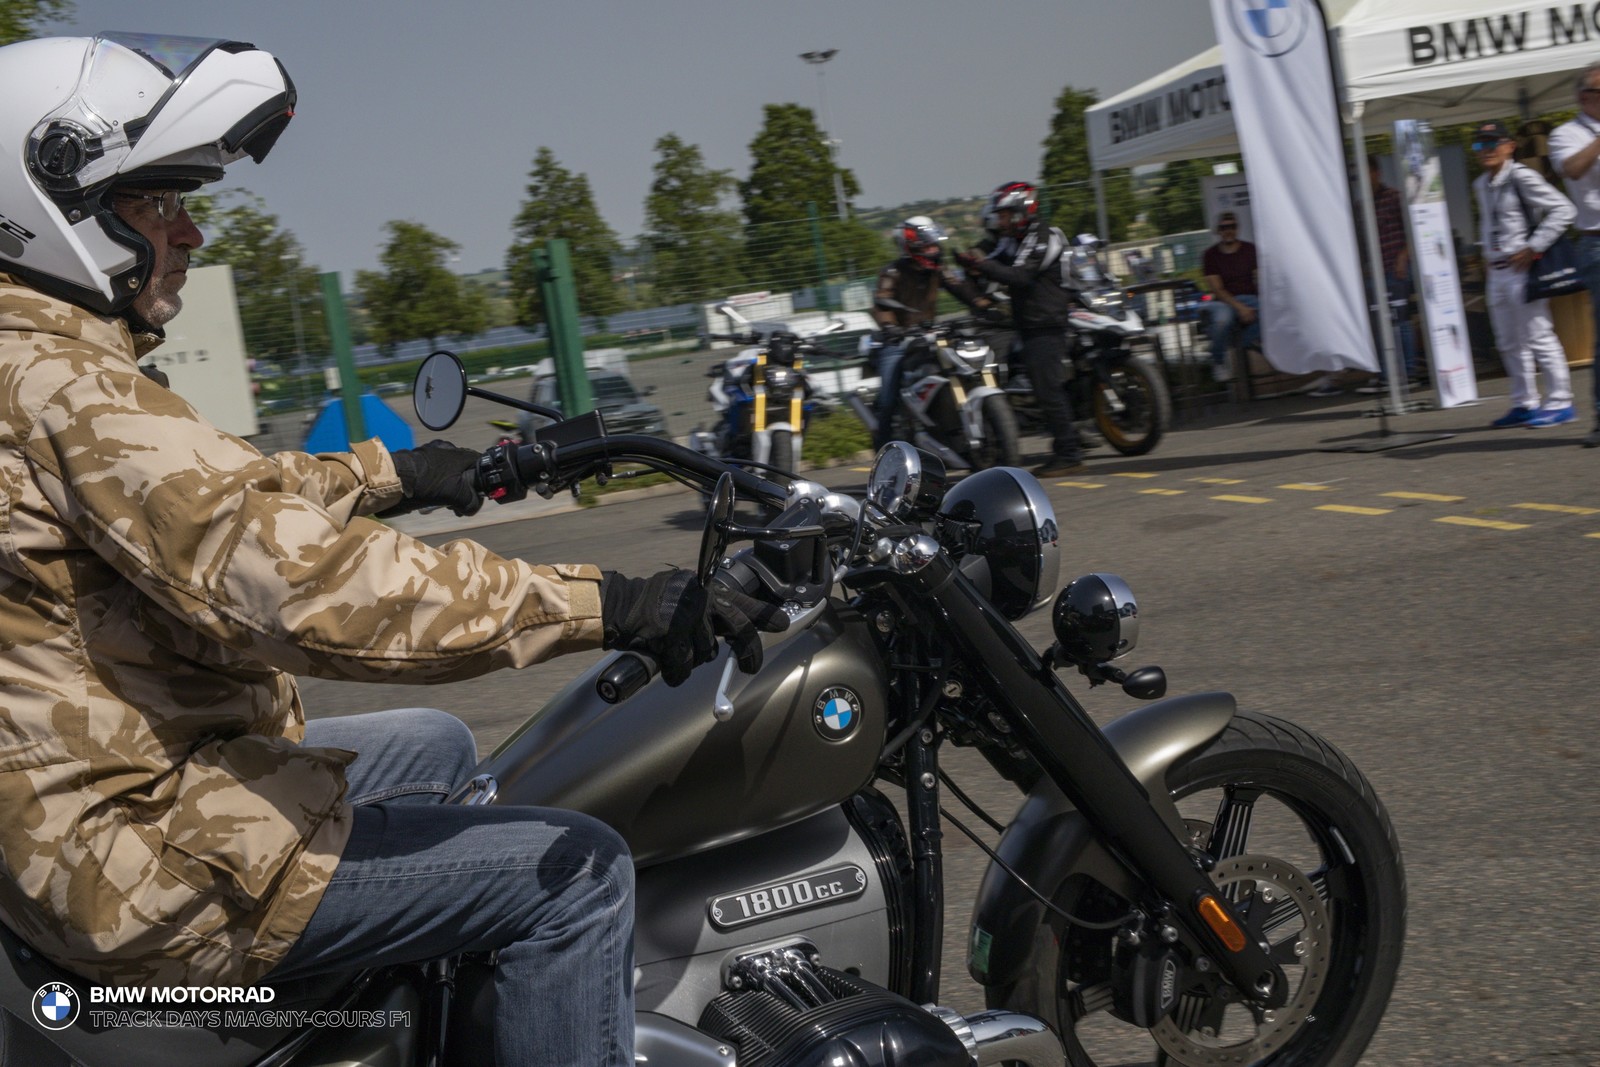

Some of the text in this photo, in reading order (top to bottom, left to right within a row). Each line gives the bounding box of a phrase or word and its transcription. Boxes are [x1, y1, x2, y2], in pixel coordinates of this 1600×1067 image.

[1406, 0, 1600, 66] BMW M
[816, 689, 854, 711] BMW
